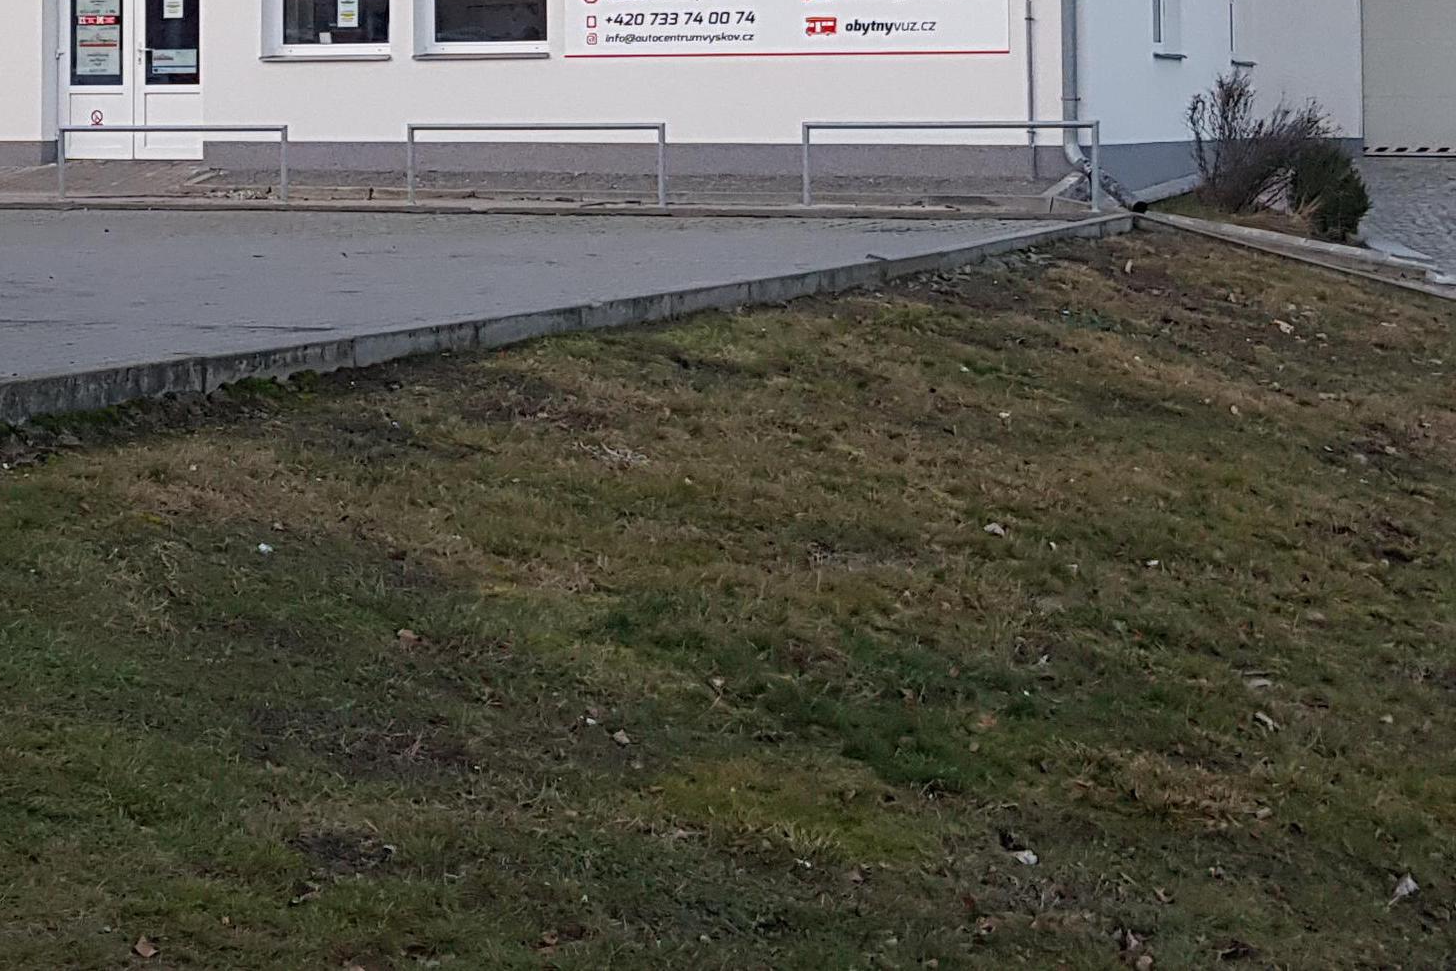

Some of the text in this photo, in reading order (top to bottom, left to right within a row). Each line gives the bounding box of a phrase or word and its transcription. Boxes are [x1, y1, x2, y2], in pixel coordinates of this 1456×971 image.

[605, 10, 756, 26] +420 733 74 00 74
[845, 19, 936, 36] obytnyvuz.cz
[605, 32, 755, 44] info@autocentrumvyskov.cz
